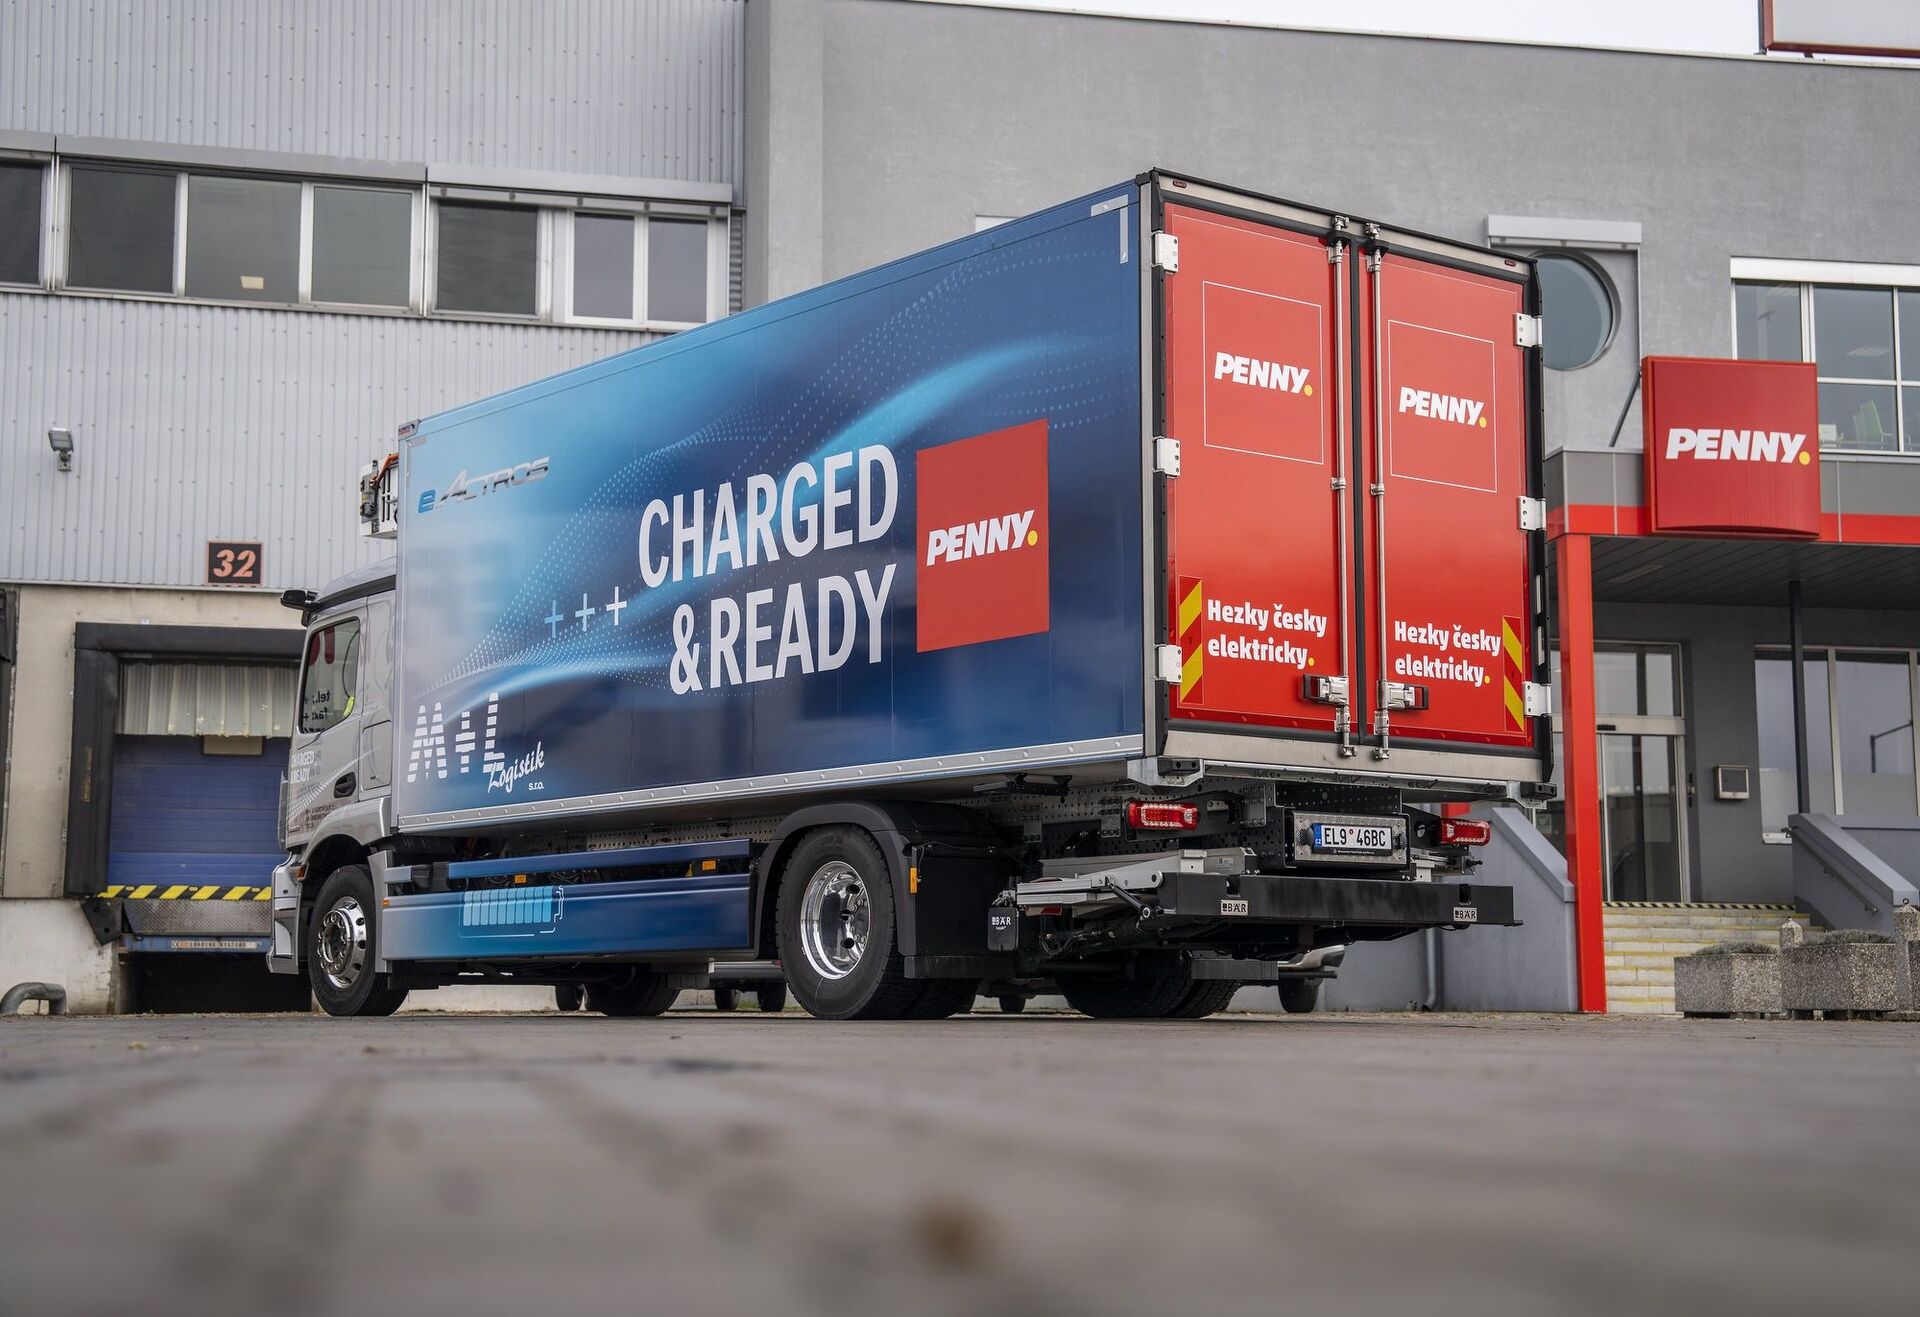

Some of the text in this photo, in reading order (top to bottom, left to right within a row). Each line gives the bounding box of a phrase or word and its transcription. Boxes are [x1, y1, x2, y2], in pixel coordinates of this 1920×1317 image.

[1213, 351, 1313, 397] PENNY.
[1398, 386, 1487, 429] PENNY.
[1665, 427, 1811, 466] PENNY.
[638, 443, 899, 588] CHARGED
[926, 509, 1038, 567] PENNY.
[213, 549, 256, 578] 32
[1207, 599, 1327, 638] Hezky česky
[1207, 634, 1315, 670] elektricky.
[1394, 620, 1501, 657] Hezky česky
[1395, 653, 1491, 688] elektricky.
[487, 740, 545, 793] Logistik
[528, 781, 545, 791] s.r.o.
[1324, 827, 1347, 846] EL9
[1356, 829, 1386, 847] 46BC
[1228, 903, 1247, 913] BÄR
[1459, 910, 1476, 919] BÄR
